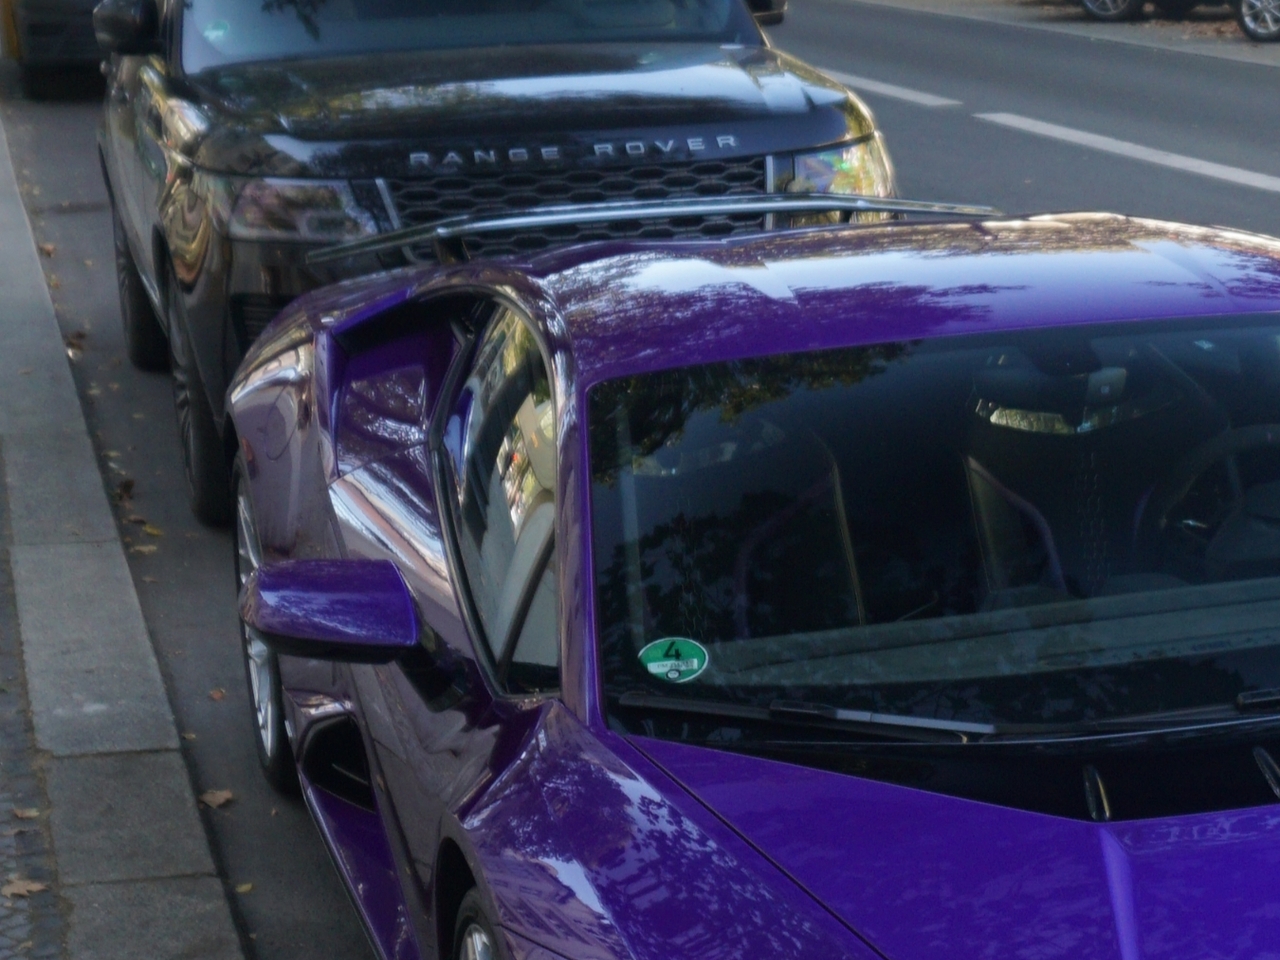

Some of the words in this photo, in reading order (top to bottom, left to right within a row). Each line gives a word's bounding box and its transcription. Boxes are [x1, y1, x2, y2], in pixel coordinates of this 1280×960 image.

[409, 147, 560, 166] RANGE
[593, 134, 737, 157] ROVER
[663, 641, 682, 660] 4
